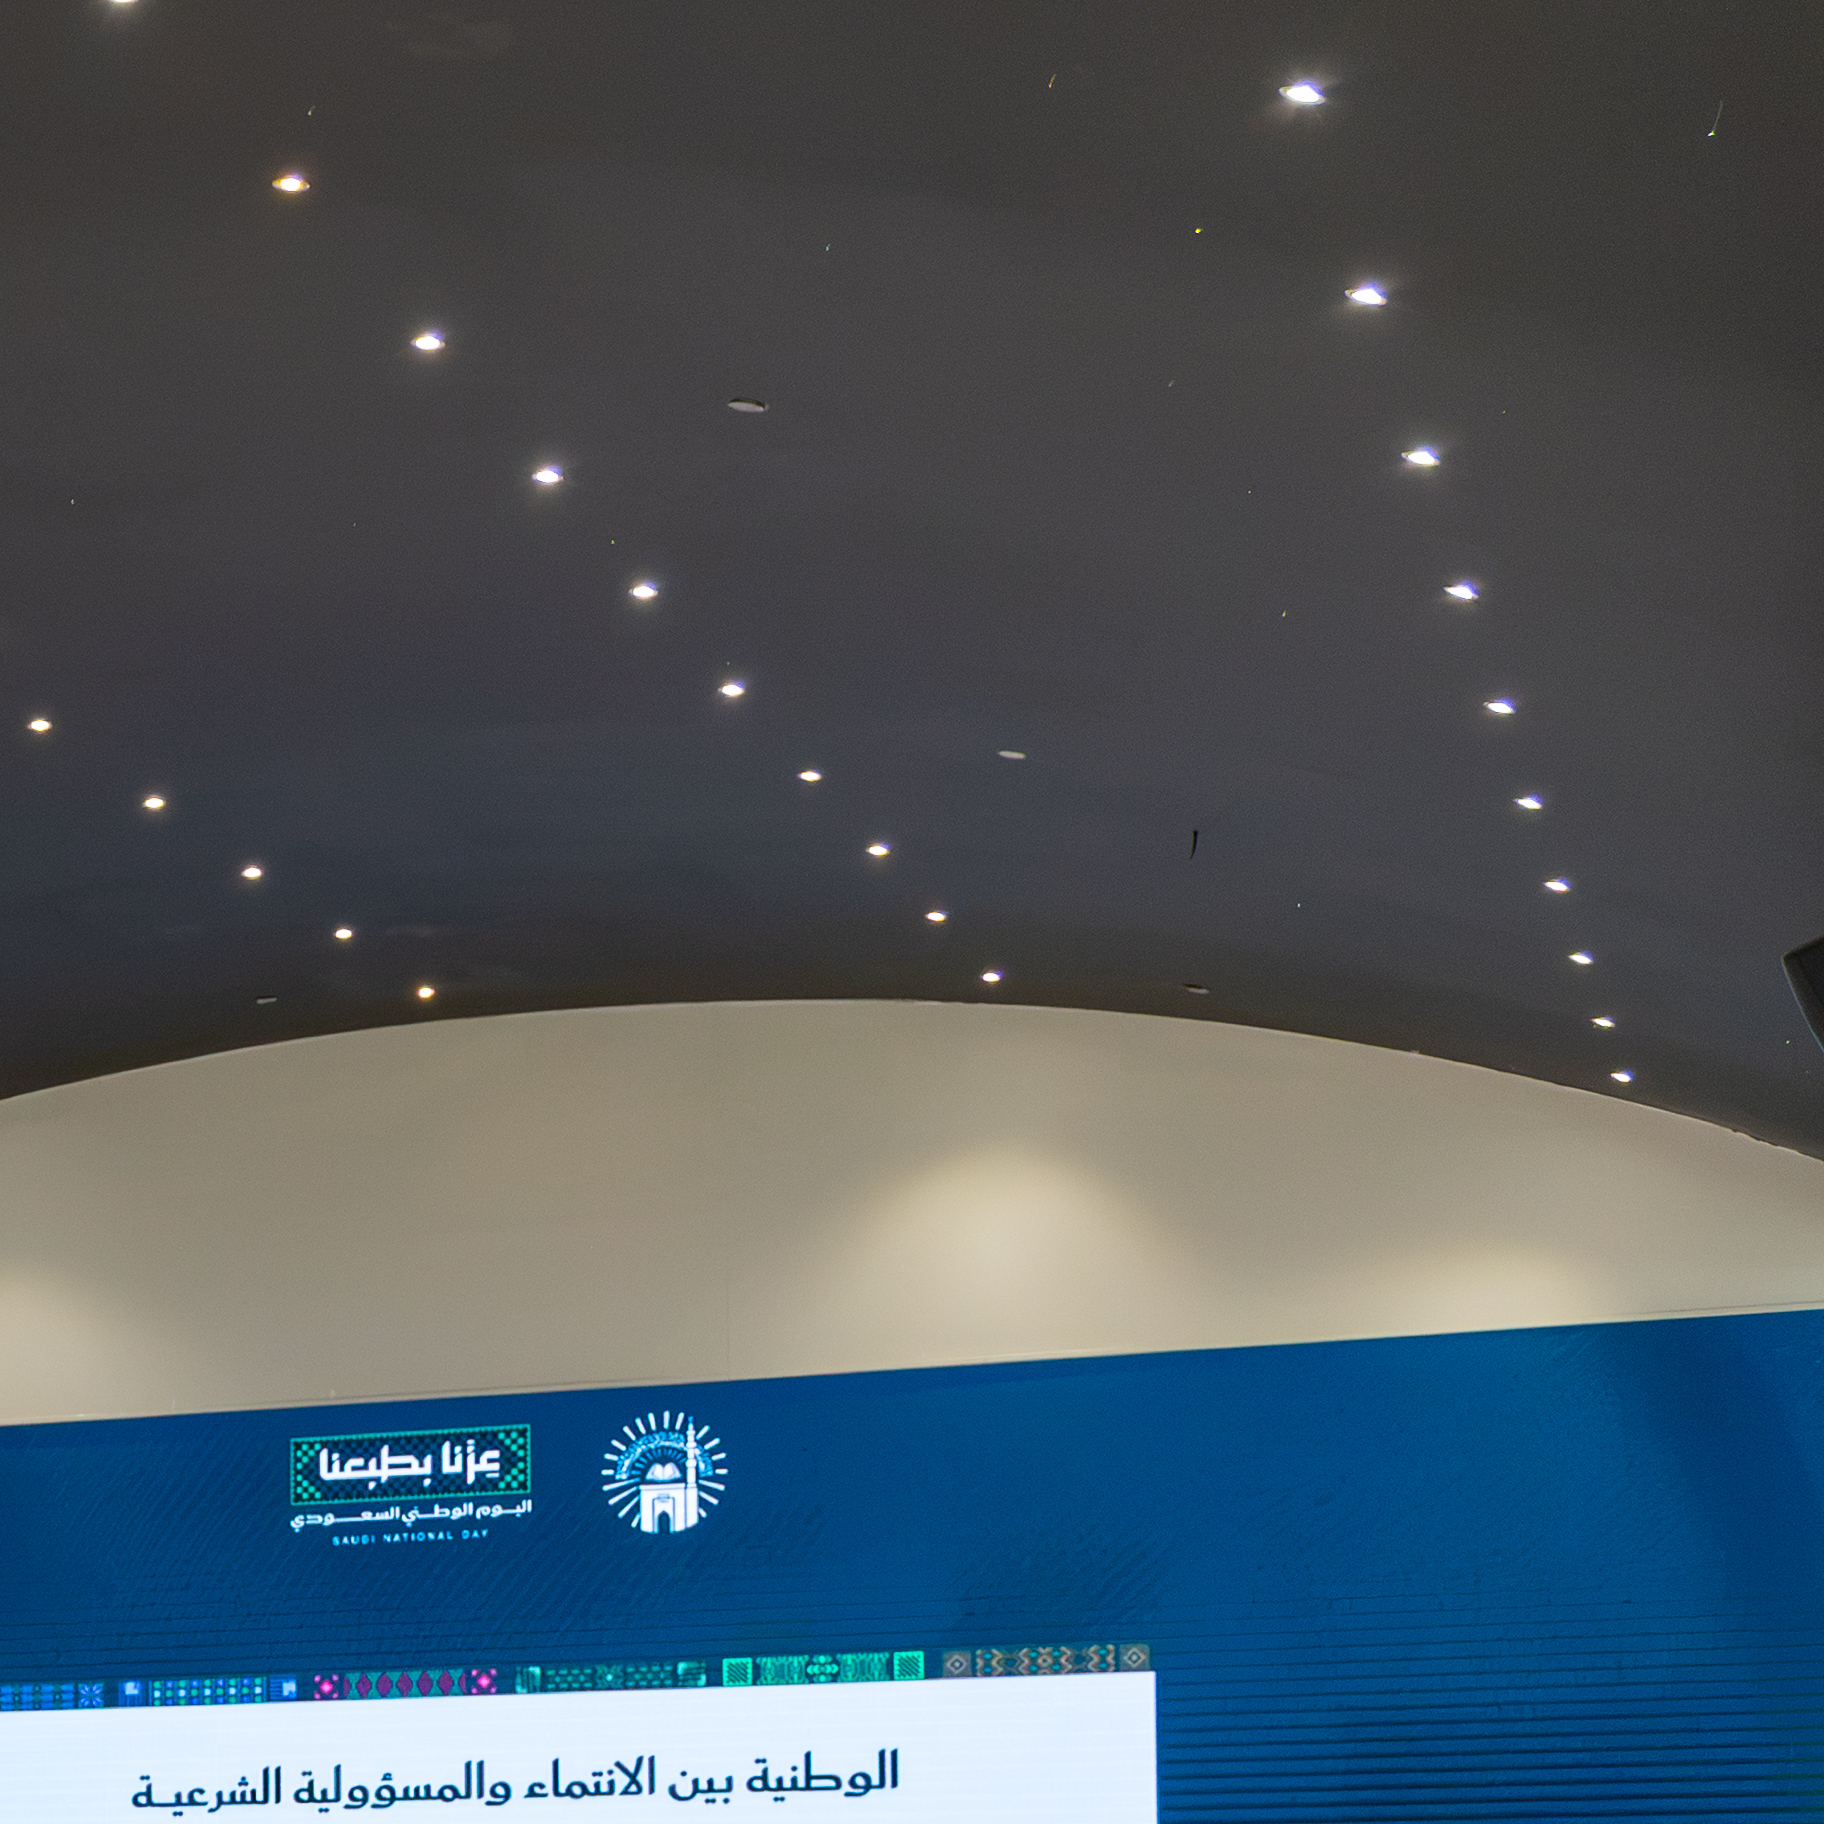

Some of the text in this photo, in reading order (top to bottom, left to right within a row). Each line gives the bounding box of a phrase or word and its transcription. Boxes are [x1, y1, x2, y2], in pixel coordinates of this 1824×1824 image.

[320, 1445, 431, 1489] بطبعنا
[290, 1500, 532, 1533] اليوم الوطني السعودي
[332, 1528, 489, 1547] SAUDI NATIONAL DAY
[132, 1749, 898, 1816] الوطنية بين الانتماء والمسؤولية الشرعية
